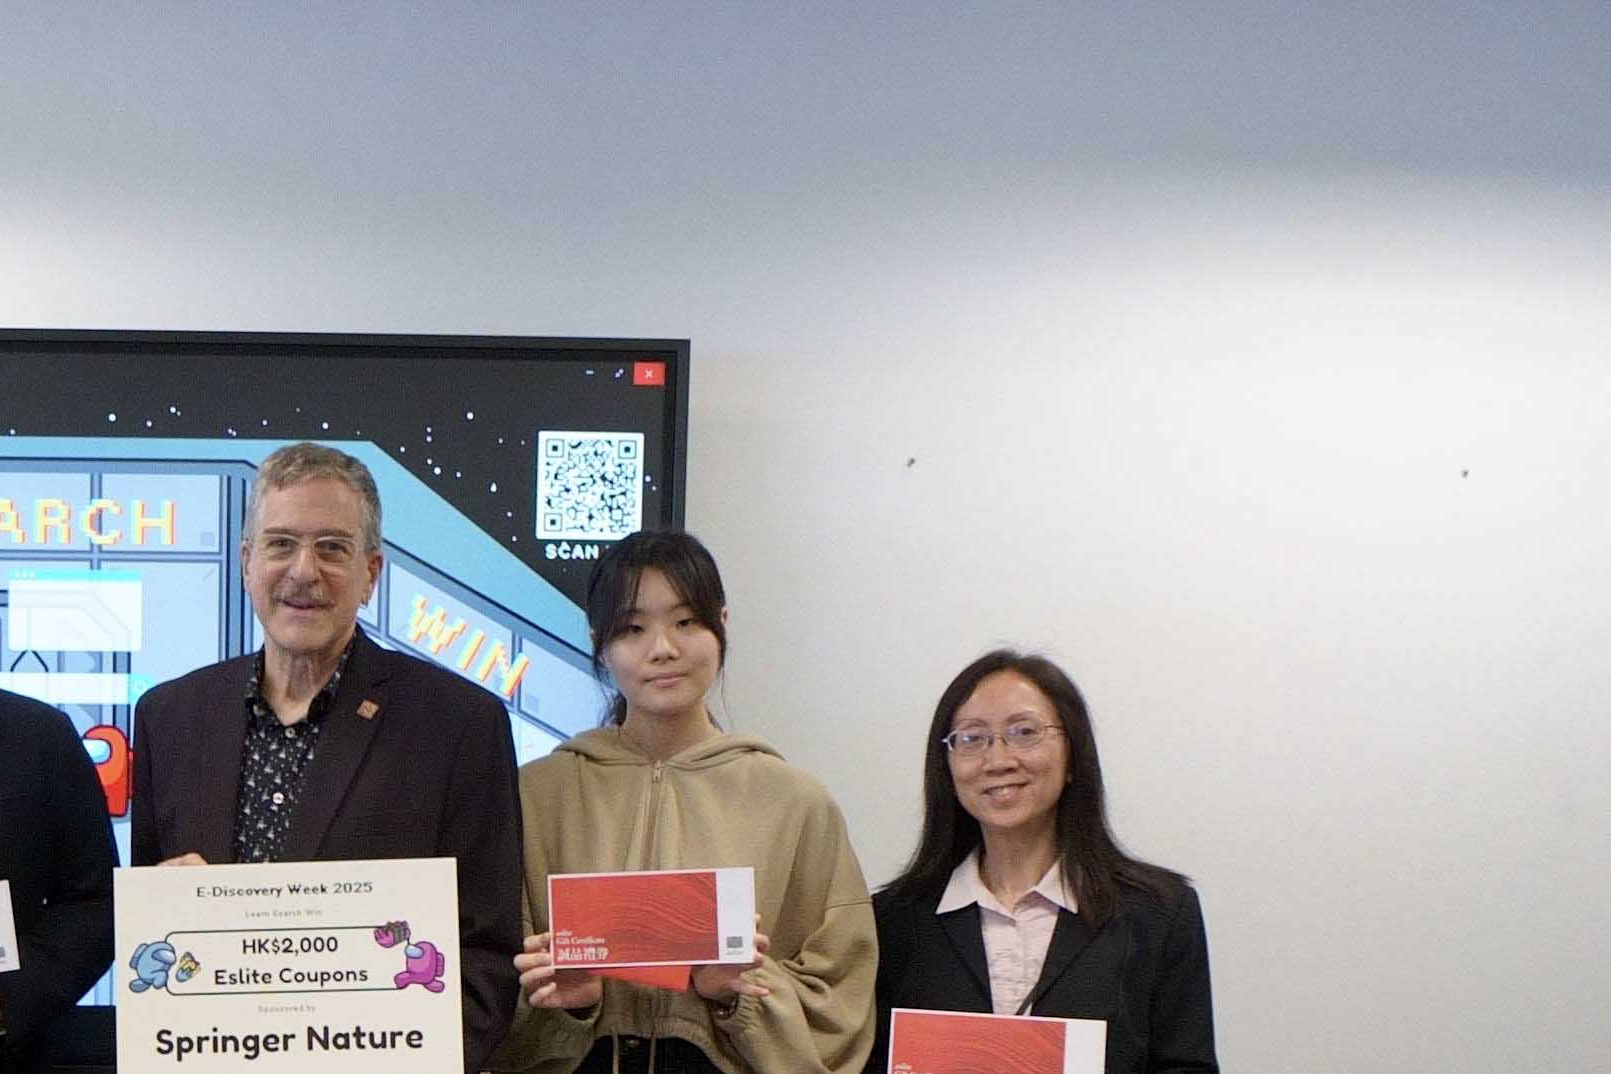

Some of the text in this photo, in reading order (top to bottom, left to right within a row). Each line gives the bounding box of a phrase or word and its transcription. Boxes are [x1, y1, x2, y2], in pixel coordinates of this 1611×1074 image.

[545, 543, 599, 560] SCAN
[407, 592, 530, 698] WIN
[197, 881, 374, 899] E-Discovery Week 2025
[242, 936, 339, 957] HK$2,000
[214, 966, 369, 988] Eslite Coupons
[155, 1025, 424, 1061] Springer Nature
